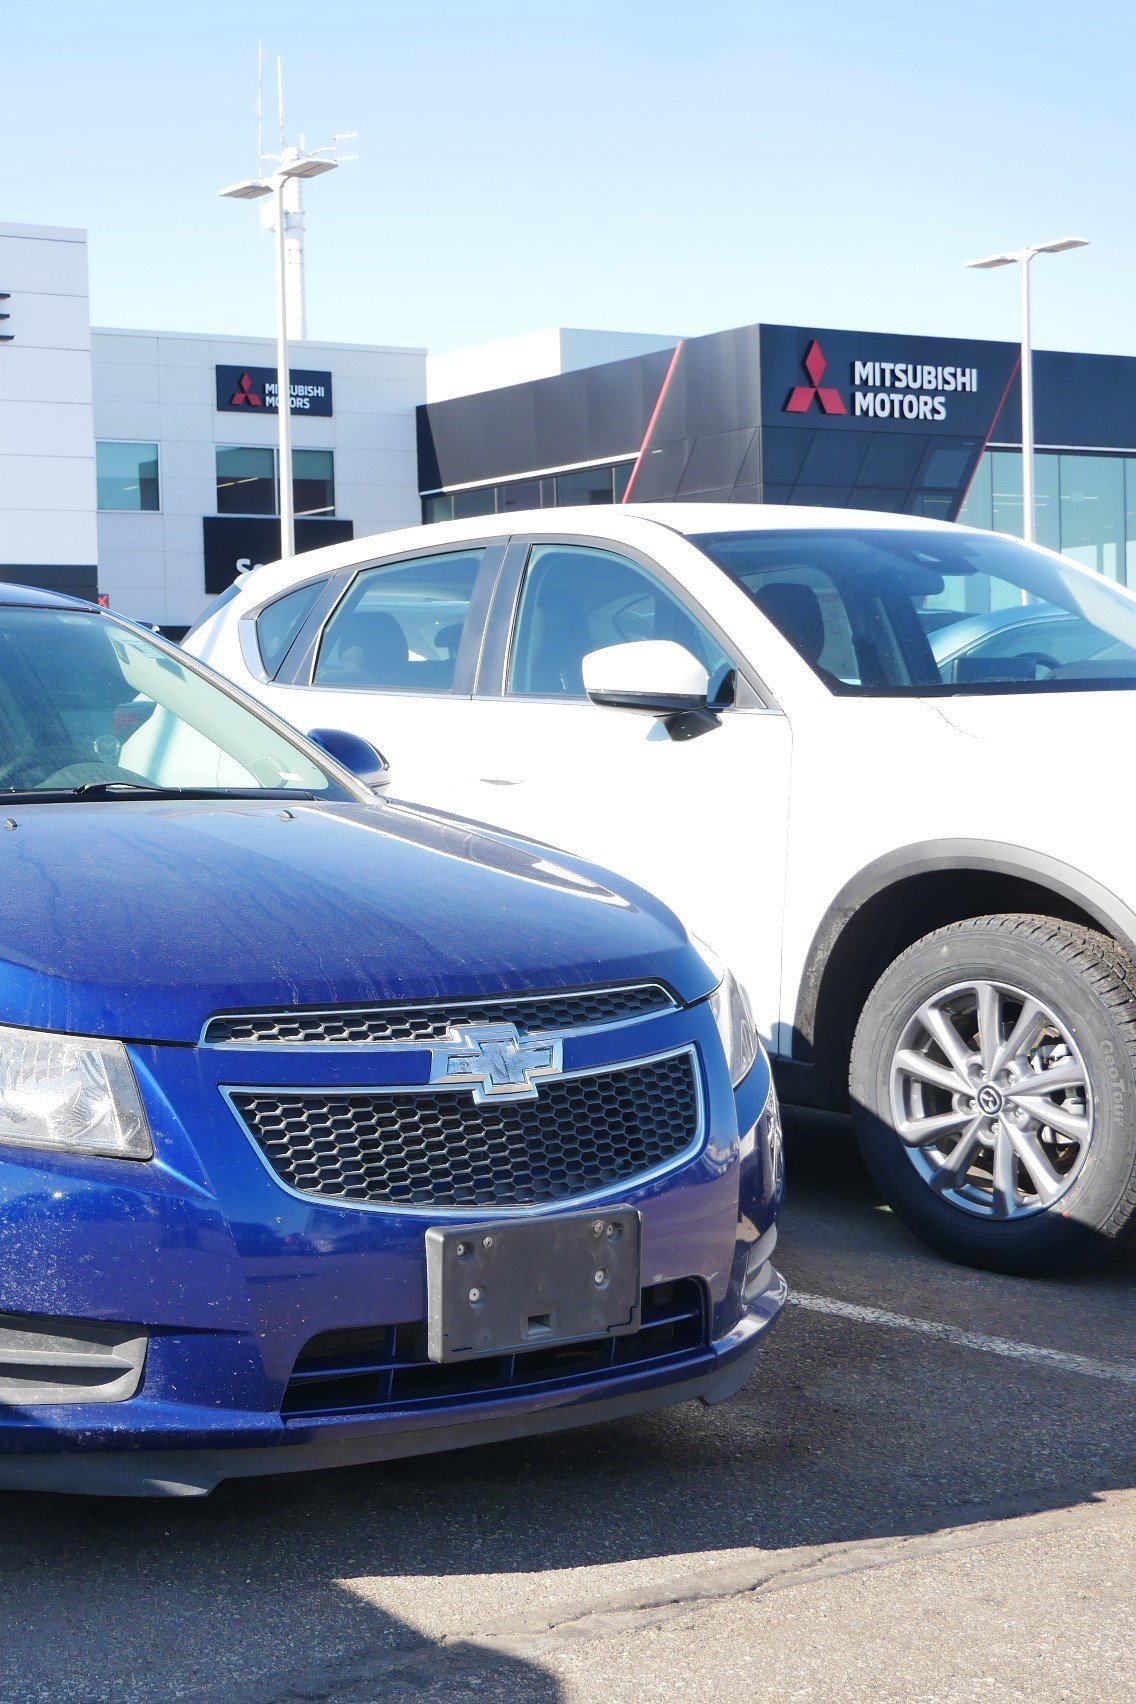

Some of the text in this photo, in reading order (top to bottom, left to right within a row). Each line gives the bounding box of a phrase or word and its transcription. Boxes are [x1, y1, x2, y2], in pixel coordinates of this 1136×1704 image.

[265, 383, 325, 397] MIUBISHI
[854, 360, 978, 392] MITSUBISHI
[854, 392, 947, 420] MOTORS
